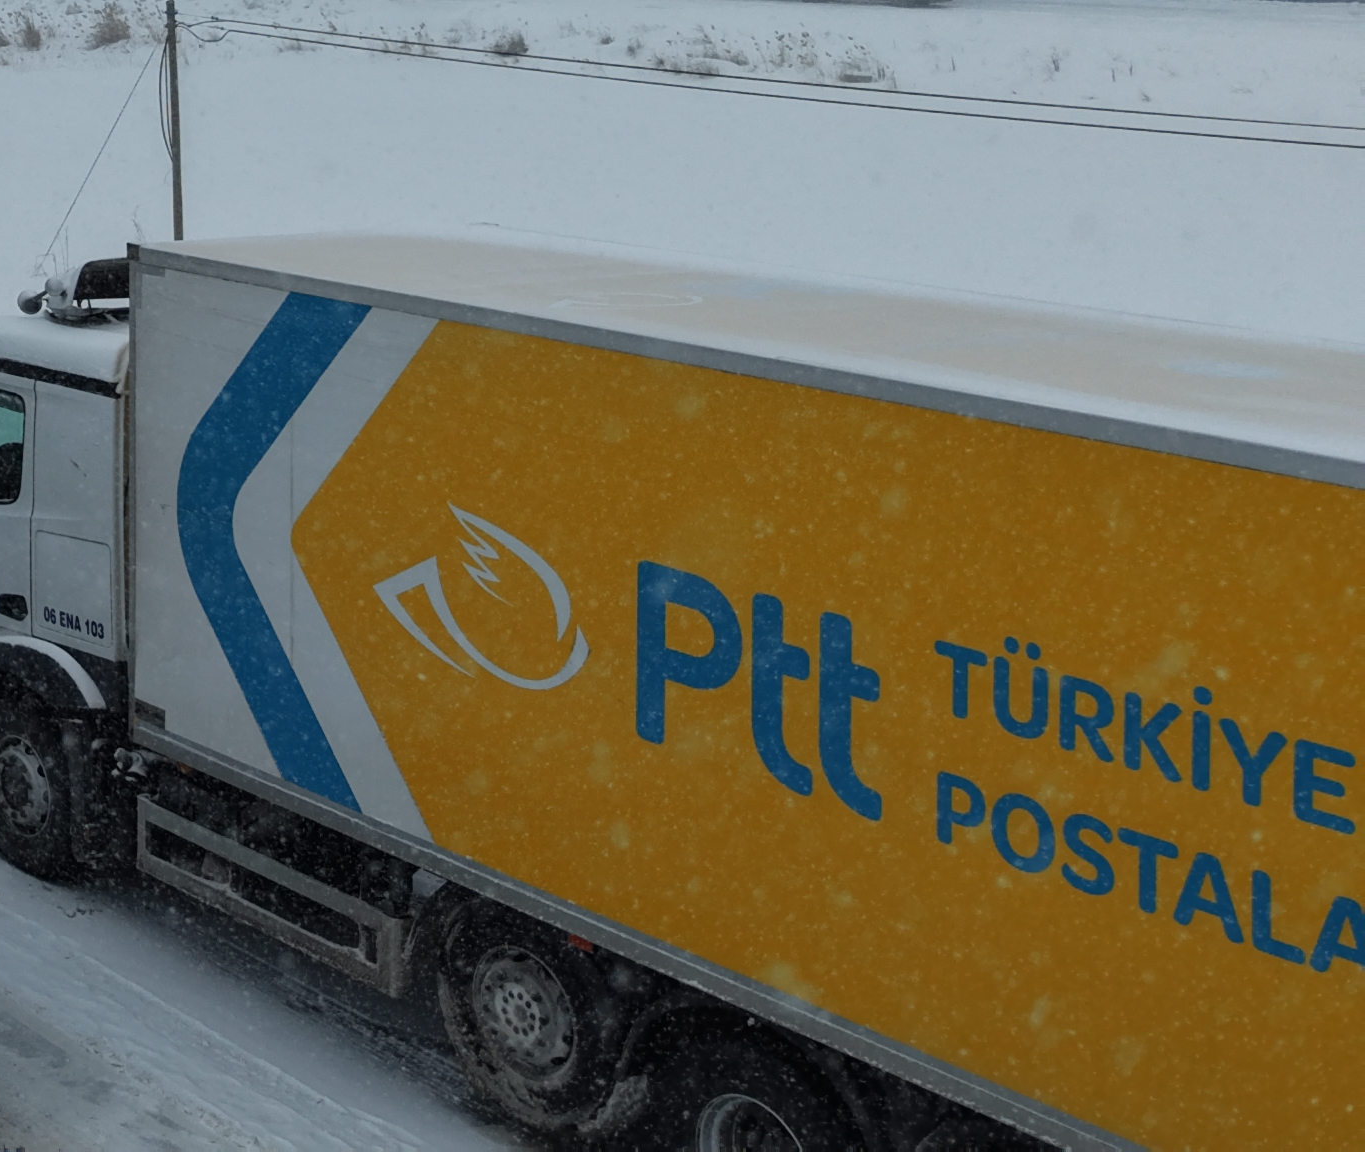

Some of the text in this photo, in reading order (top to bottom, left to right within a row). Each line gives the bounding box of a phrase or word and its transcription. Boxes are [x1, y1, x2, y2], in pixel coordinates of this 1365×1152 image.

[43, 606, 105, 640] 06 ENA 103
[934, 636, 1356, 835] TÜRKİYE
[936, 771, 1365, 973] POSTALA
